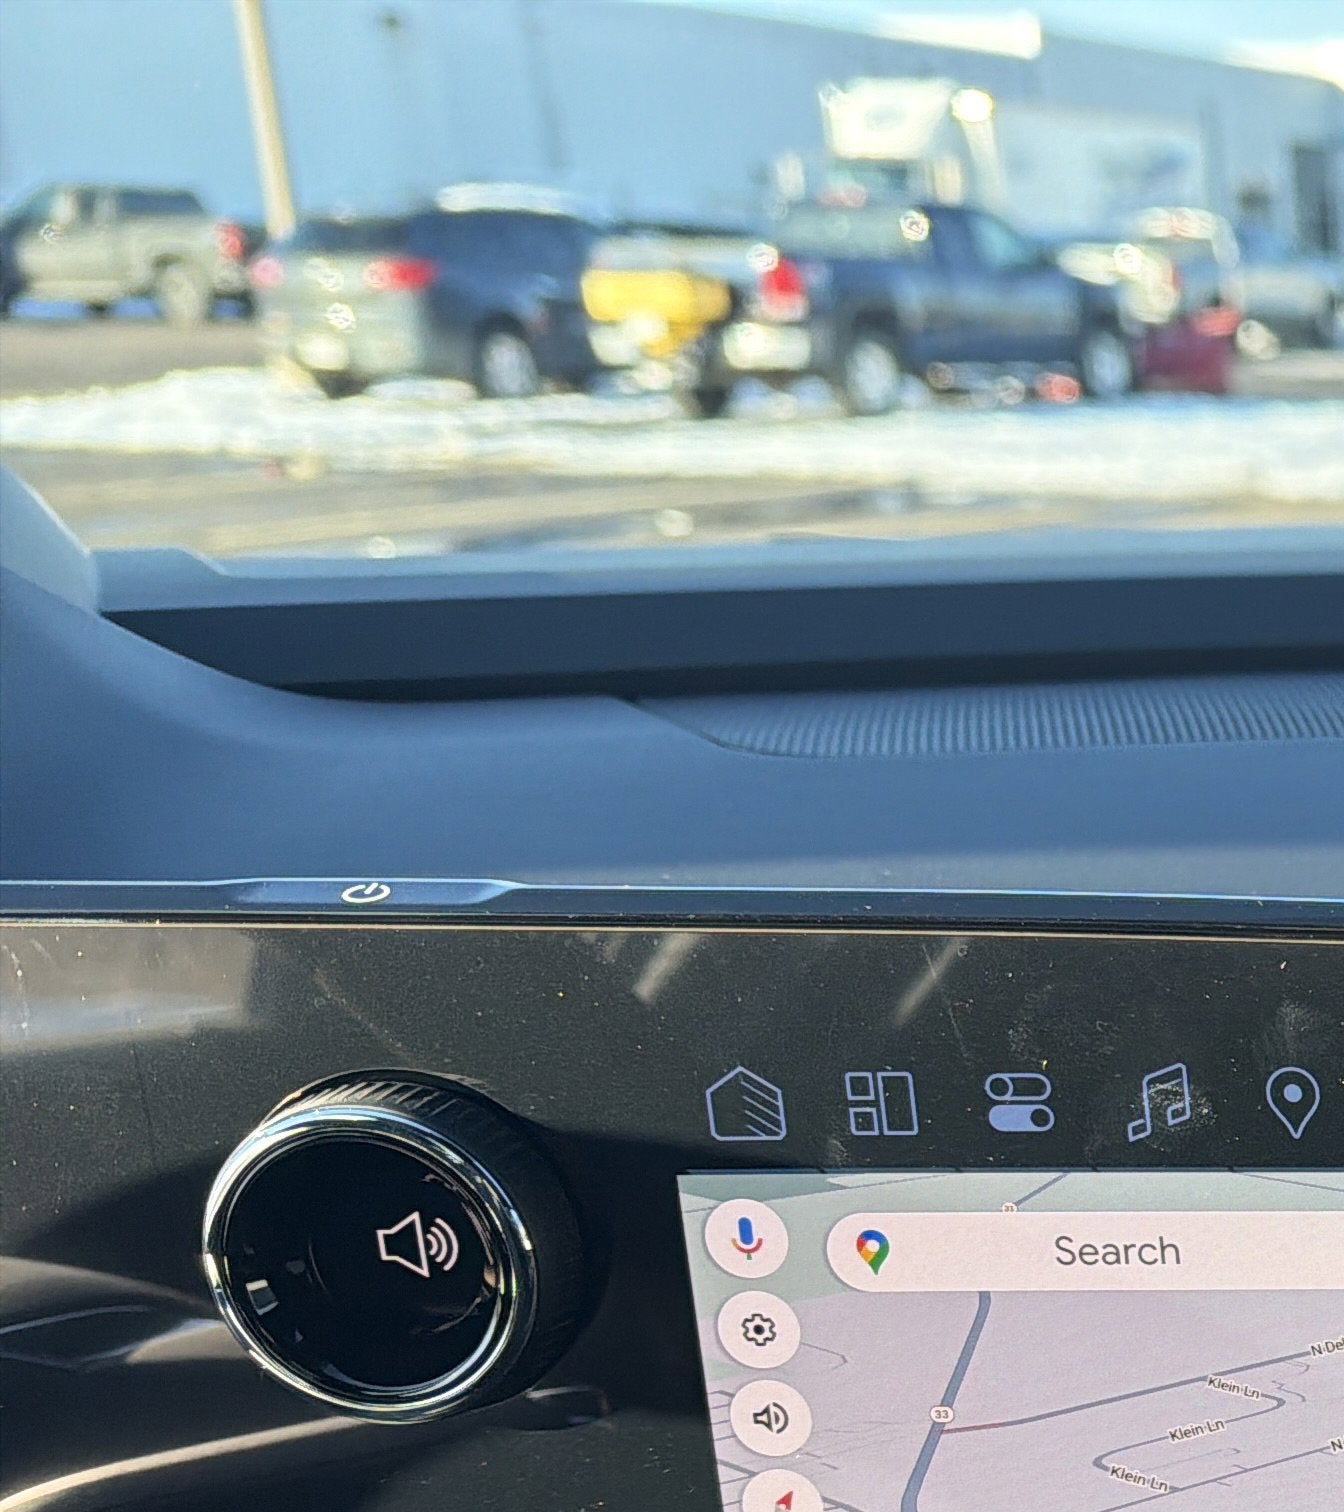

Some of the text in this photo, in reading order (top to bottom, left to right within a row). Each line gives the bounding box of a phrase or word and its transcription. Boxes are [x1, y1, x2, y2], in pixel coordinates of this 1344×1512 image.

[1055, 1236, 1180, 1265] Search
[1311, 1344, 1323, 1356] N
[1208, 1376, 1260, 1399] Klein Ln
[934, 1409, 949, 1419] 33
[1169, 1419, 1224, 1442] Klein Ln
[1331, 1439, 1343, 1452] N
[1110, 1466, 1168, 1492] Klein Ln
